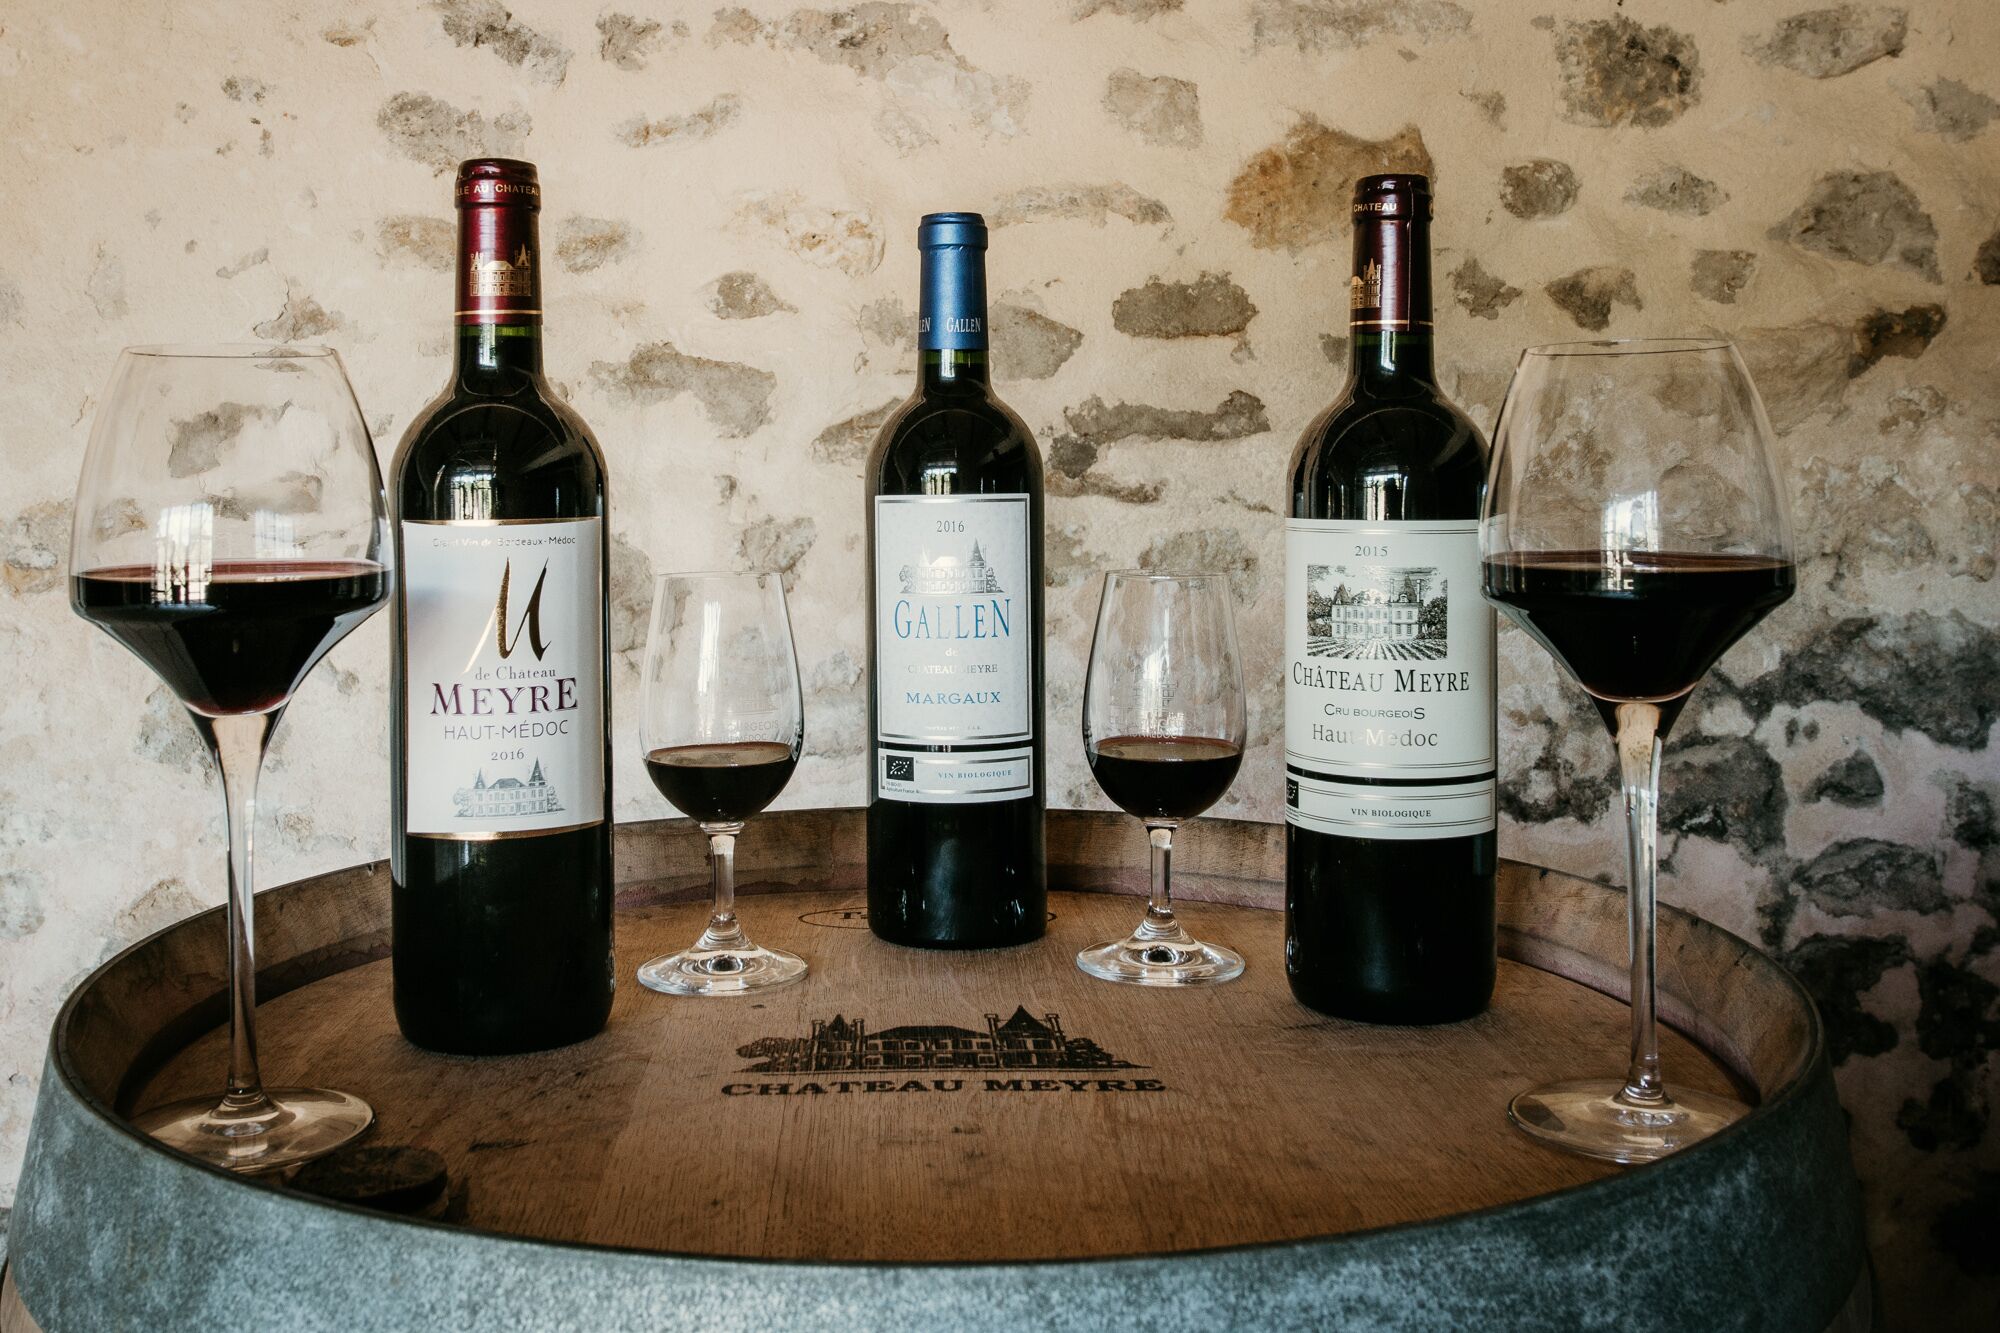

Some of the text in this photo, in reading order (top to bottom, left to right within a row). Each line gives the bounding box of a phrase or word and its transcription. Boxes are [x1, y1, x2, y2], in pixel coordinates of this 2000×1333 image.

[474, 184, 489, 193] AU
[1353, 202, 1397, 212] CHATEAU
[946, 317, 981, 333] GALLEN
[936, 520, 965, 533] 2016
[1354, 545, 1389, 557] 2015
[894, 598, 1011, 639] GALLEN
[475, 667, 490, 681] de
[1394, 669, 1470, 693] MEYRE
[430, 677, 578, 716] MEYRE
[906, 691, 1001, 705] MARGAUX
[444, 720, 569, 741] HAUT-MÉDOC
[491, 749, 525, 761] 2016
[938, 769, 1012, 779] VIN BIOLOGIQUE
[1351, 808, 1432, 818] VIN BIOLOGIQUE
[721, 1078, 1167, 1097] CHATEAU MEYRE
